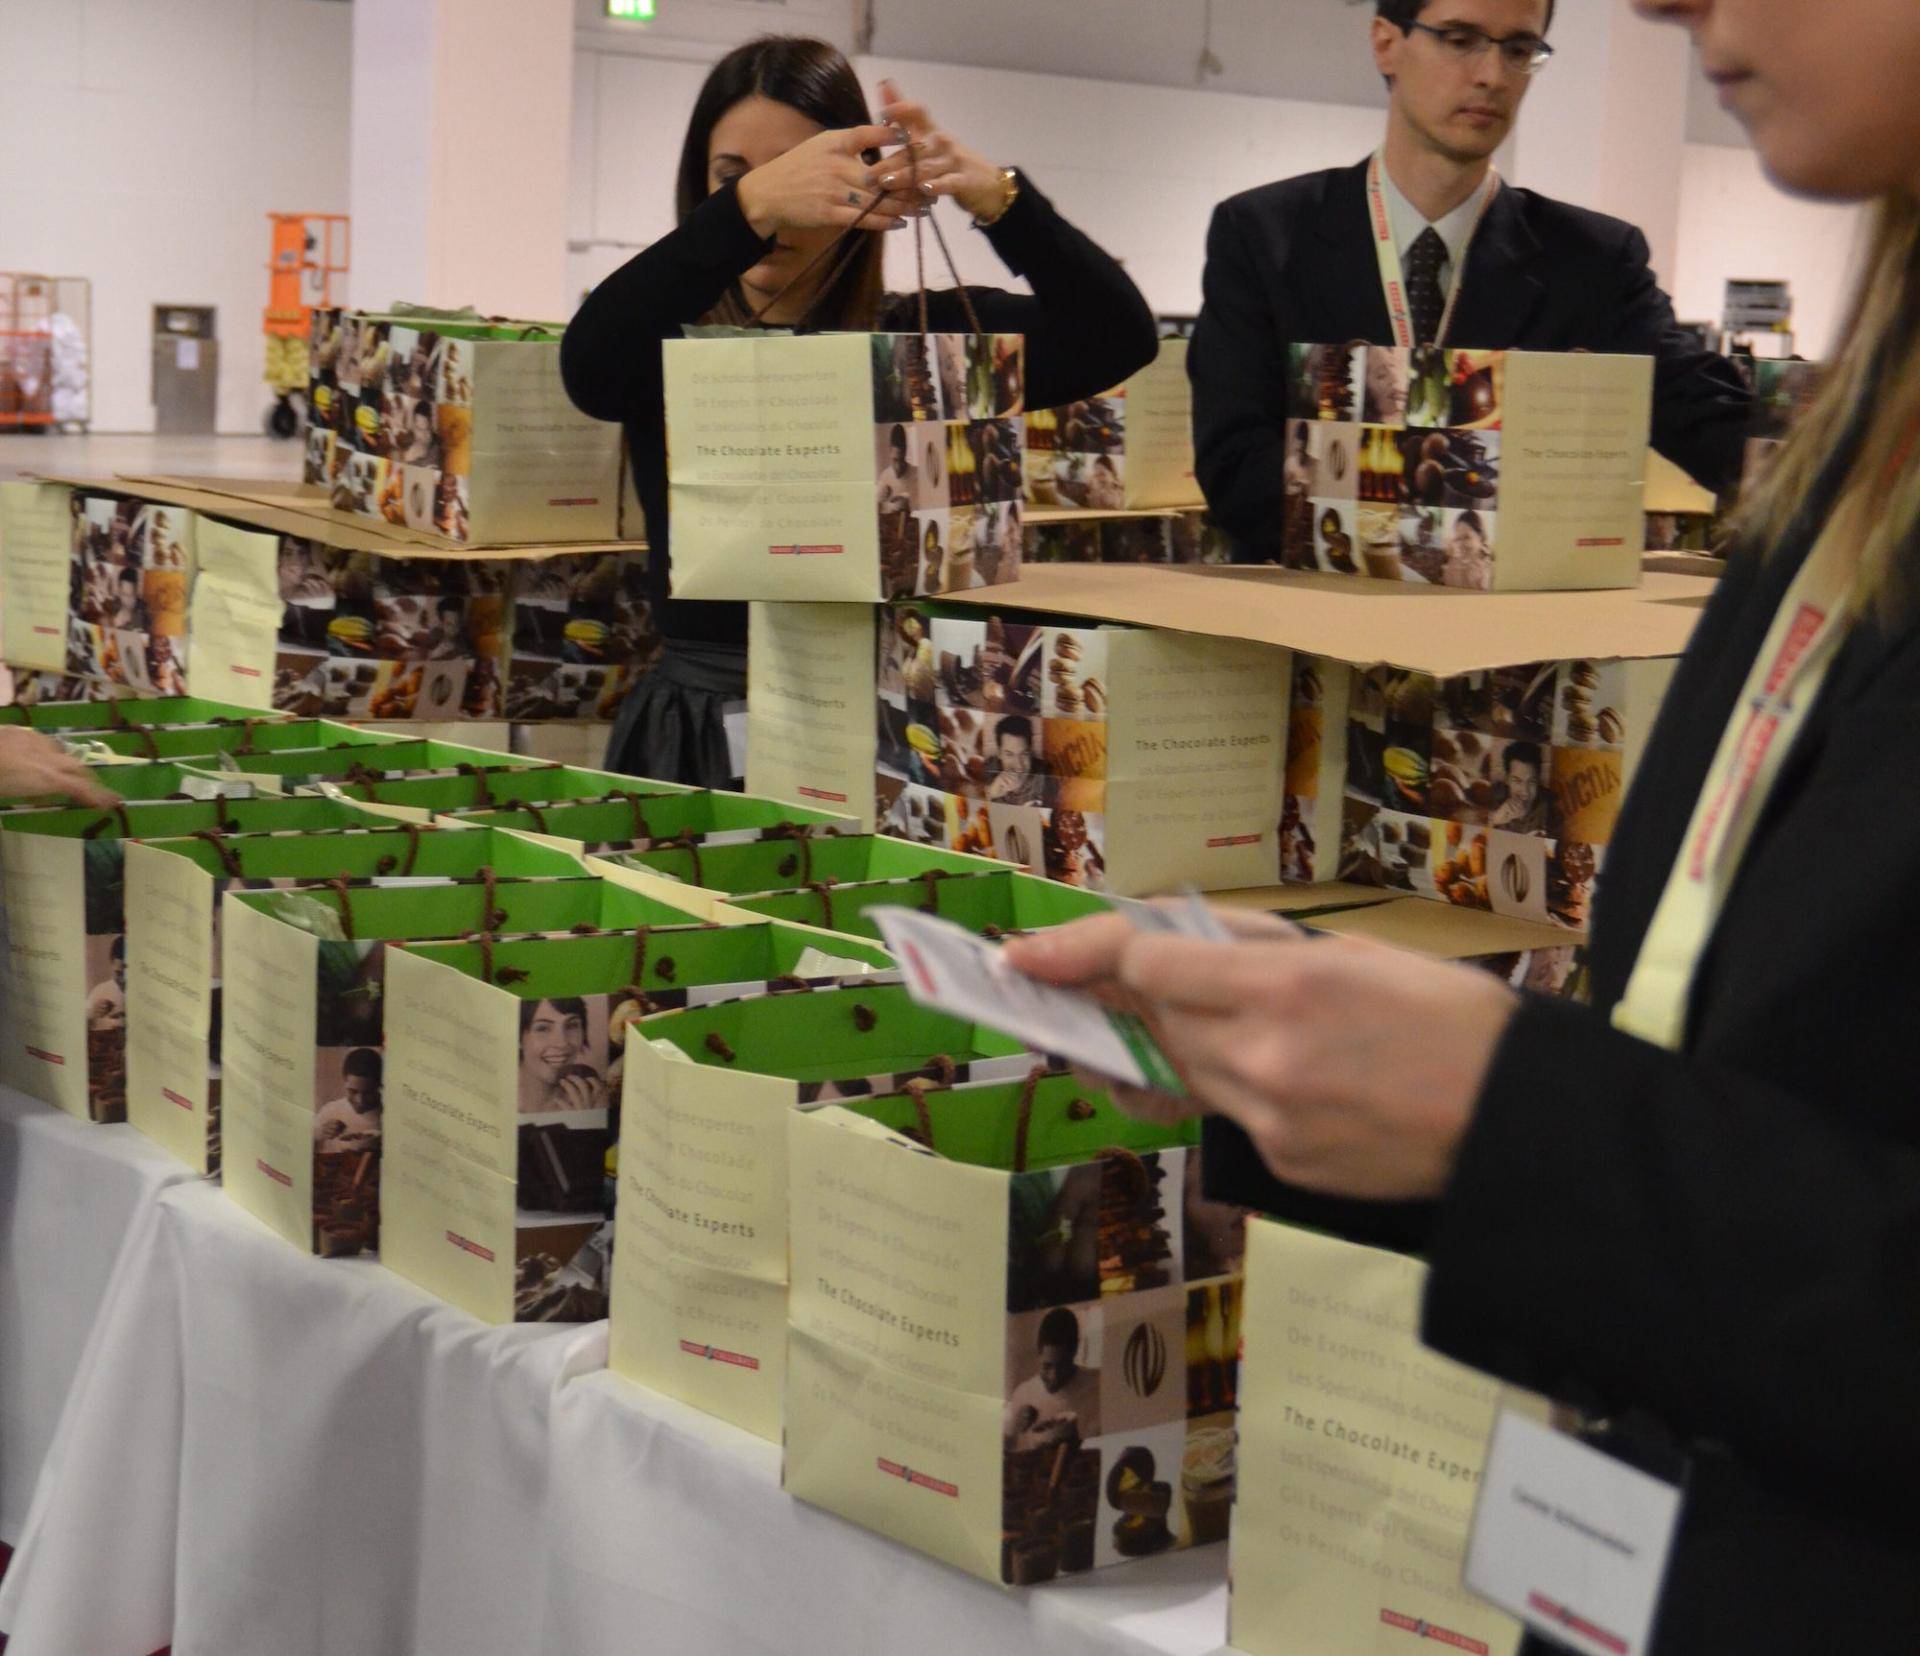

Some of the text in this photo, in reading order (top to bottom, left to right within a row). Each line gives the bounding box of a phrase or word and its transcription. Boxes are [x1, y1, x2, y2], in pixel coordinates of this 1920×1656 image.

[696, 443, 842, 460] The Chocolate Experts
[1135, 739, 1158, 751] The
[1161, 735, 1227, 751] Chocolate
[693, 1212, 755, 1239] Experts
[817, 1276, 960, 1348] The Chocolate Experts
[1283, 1405, 1484, 1483] The Chocolate Exper
